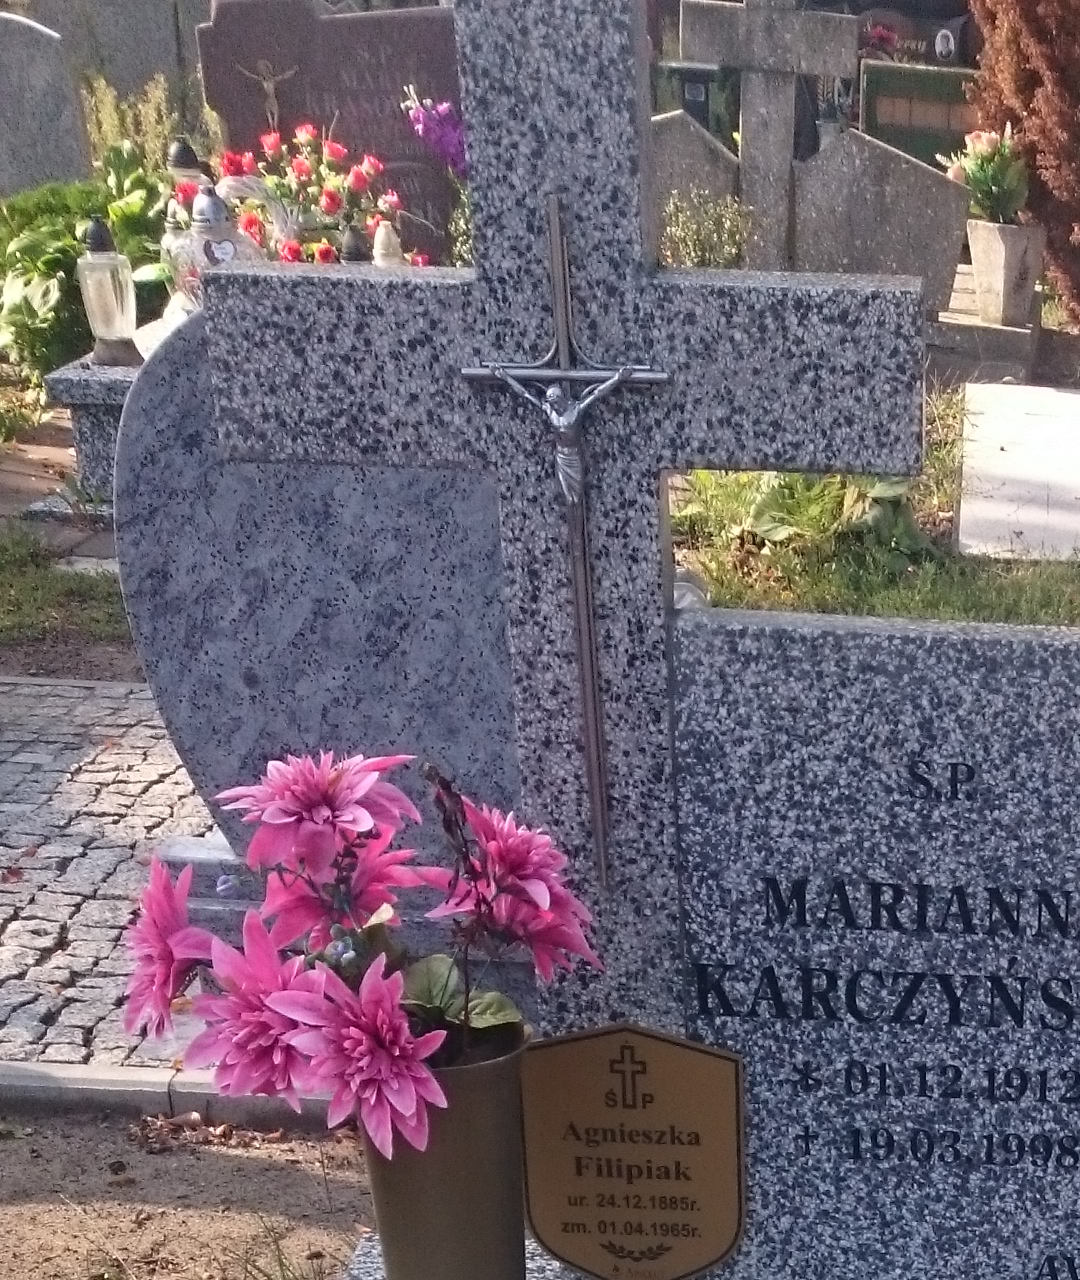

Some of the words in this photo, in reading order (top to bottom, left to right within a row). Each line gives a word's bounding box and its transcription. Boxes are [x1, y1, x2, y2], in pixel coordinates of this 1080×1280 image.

[562, 1121, 701, 1147] Agnieszka
[848, 1127, 1080, 1168] 19.03.1998
[574, 1156, 693, 1184] Filipiak
[567, 1194, 589, 1207] ur.
[561, 1221, 591, 1234] zm.
[597, 1219, 701, 1238] 01.04.1965r.
